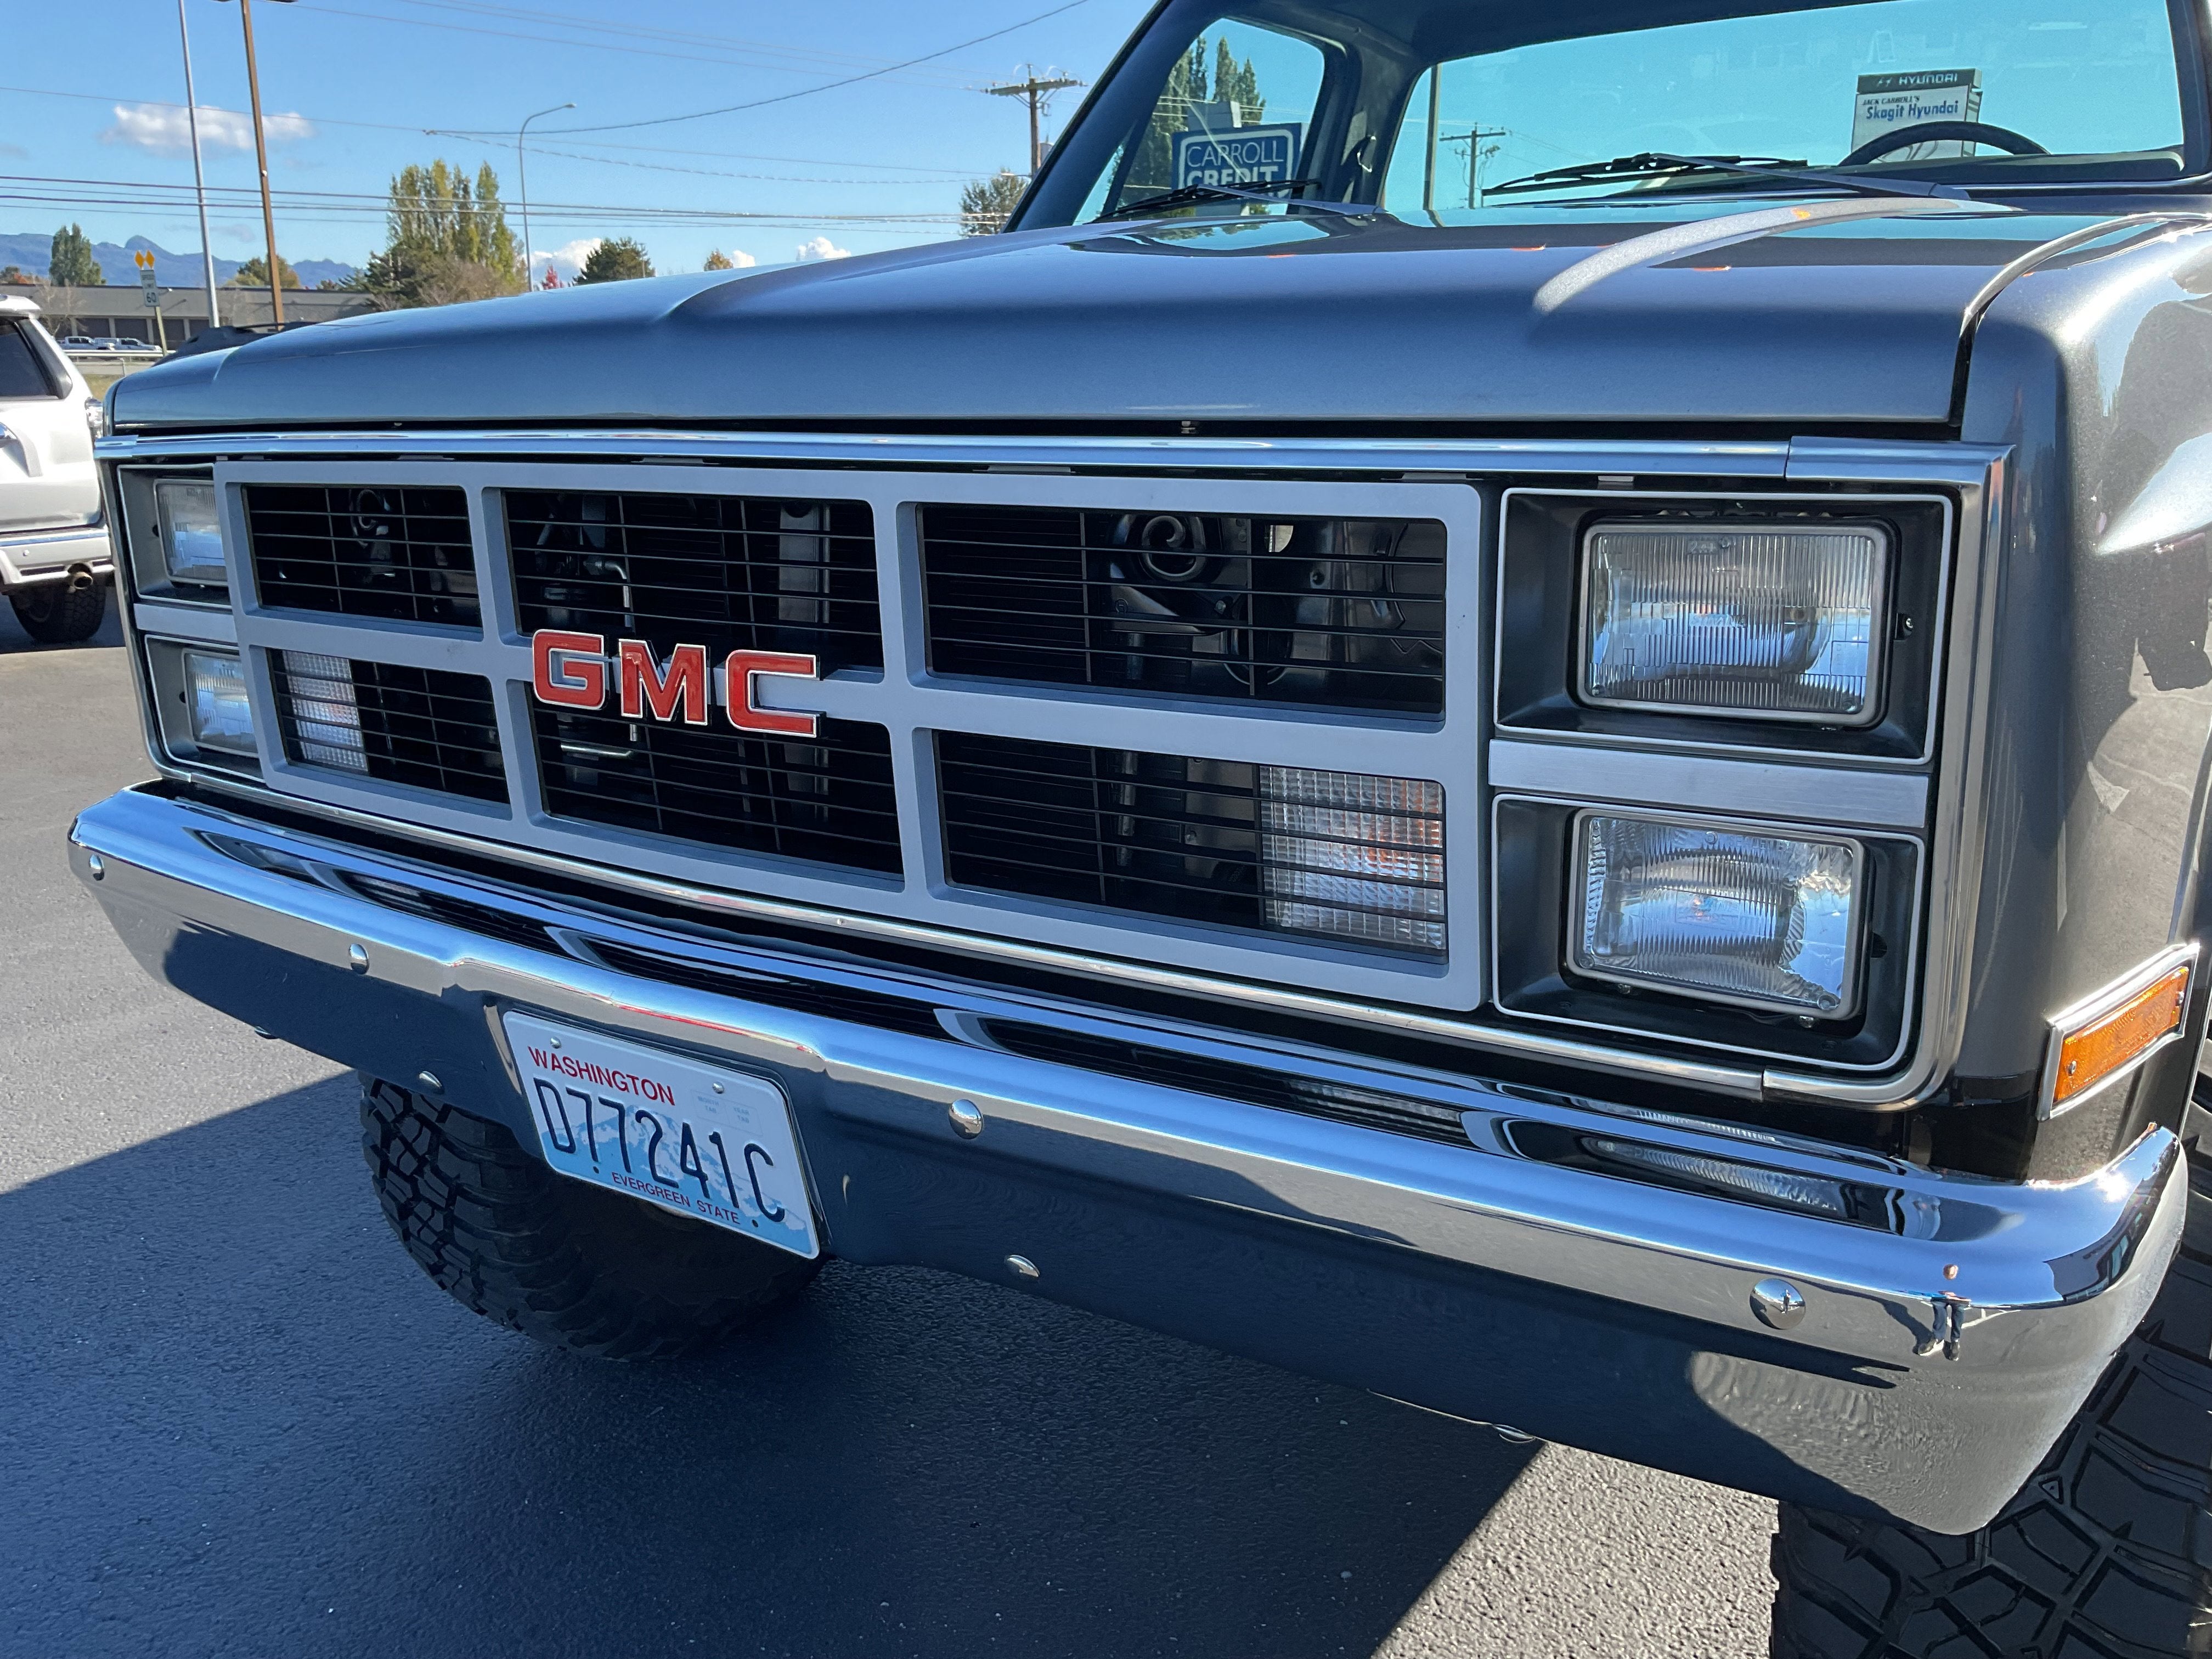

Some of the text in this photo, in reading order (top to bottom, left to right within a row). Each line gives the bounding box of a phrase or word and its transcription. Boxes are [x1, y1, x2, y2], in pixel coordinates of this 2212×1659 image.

[1898, 72, 1958, 86] HYUNDAI
[1866, 100, 1959, 122] Skagit Hyundai
[1187, 139, 1284, 167] CARROLL
[1186, 165, 1279, 187] CREDIT
[146, 292, 157, 303] 60
[532, 629, 817, 738] GMC
[528, 1046, 676, 1107] WASHINGTON
[533, 1077, 786, 1223] D77241C
[611, 1171, 741, 1225] EVERGREEN STATE
